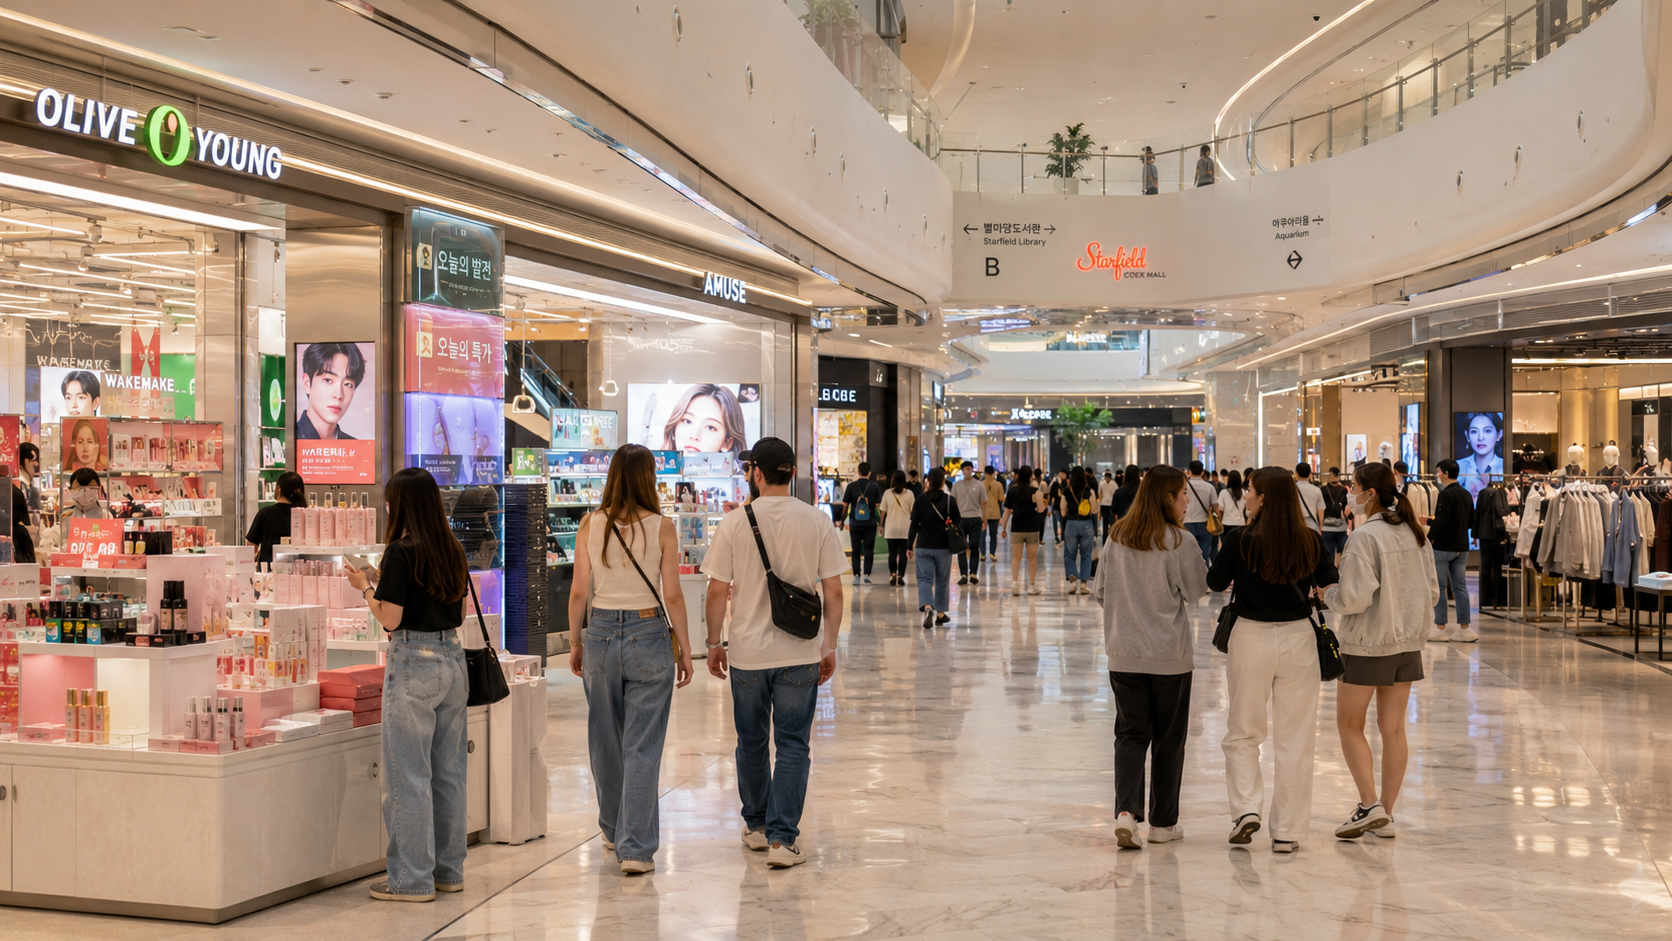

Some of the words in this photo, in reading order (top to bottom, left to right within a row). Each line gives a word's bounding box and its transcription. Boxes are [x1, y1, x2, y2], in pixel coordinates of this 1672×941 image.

[35, 87, 138, 145] OLIVE
[193, 126, 282, 180] YOUNG
[983, 237, 1017, 246] Starfield
[1018, 237, 1046, 247] Library
[1275, 230, 1309, 241] Aquarium
[438, 250, 469, 278] 오늘의
[985, 257, 1000, 277] B
[1076, 241, 1148, 281] Starfield
[703, 271, 747, 304] AMUSE
[437, 337, 469, 361] 오늘의
[471, 341, 493, 364] 특가
[104, 373, 175, 392] WAKEMAKE
